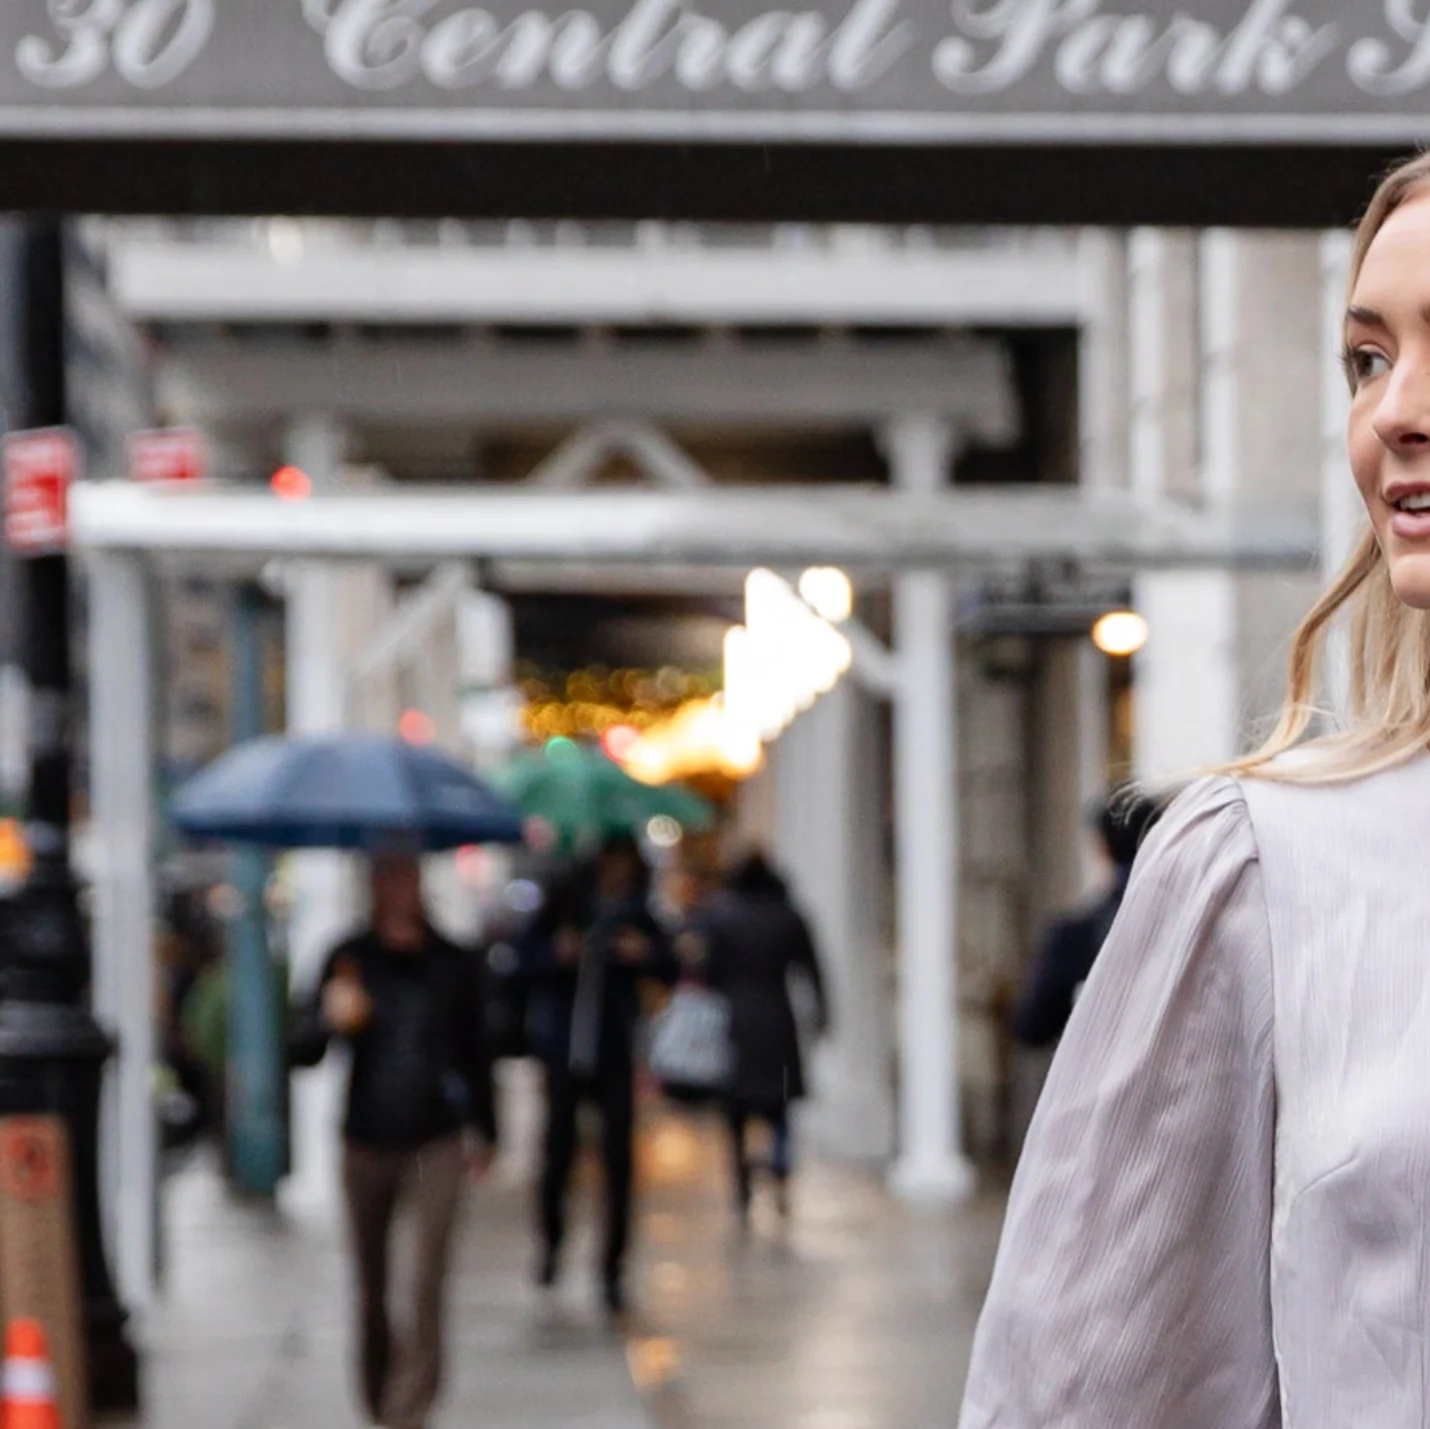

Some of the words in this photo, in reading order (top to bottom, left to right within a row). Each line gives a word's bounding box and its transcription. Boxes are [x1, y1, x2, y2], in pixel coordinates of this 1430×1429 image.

[14, 0, 214, 90] 30
[302, 0, 915, 92] Central
[931, 0, 1342, 95] Park
